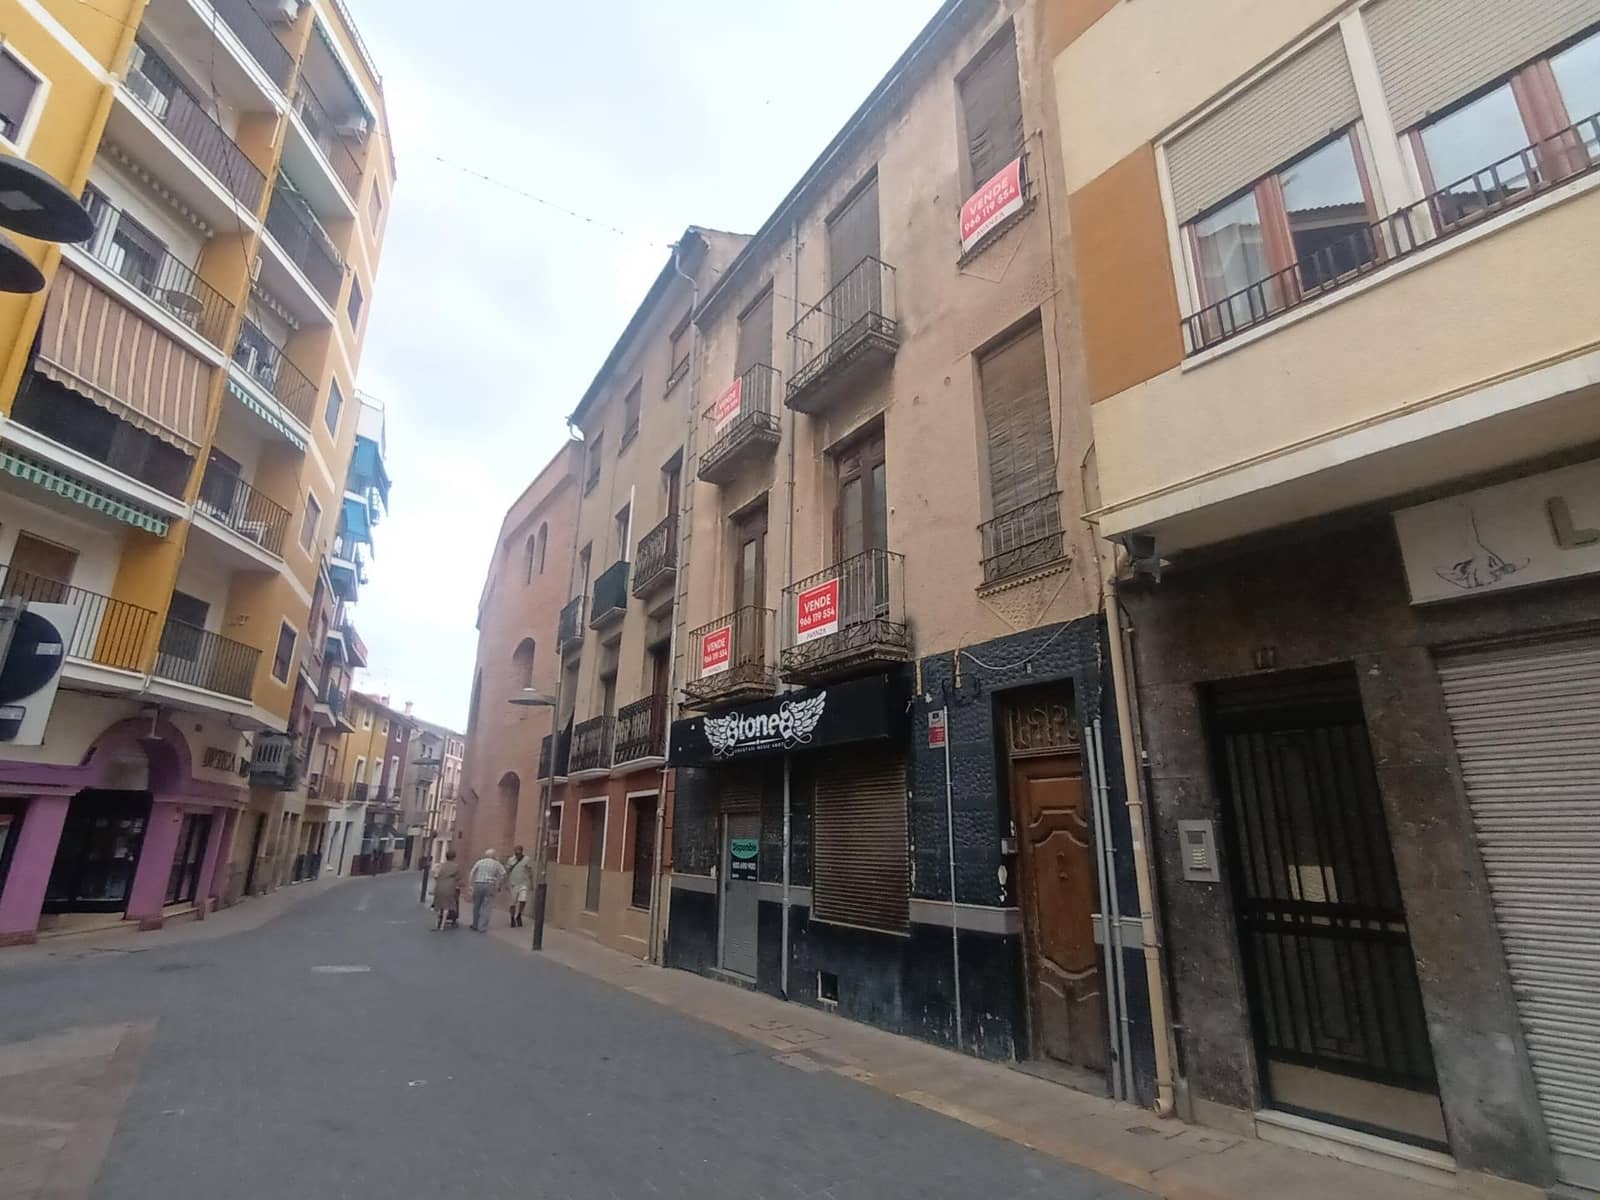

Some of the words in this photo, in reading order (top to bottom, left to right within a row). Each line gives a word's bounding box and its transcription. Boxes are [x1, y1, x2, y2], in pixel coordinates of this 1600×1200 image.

[970, 177, 1009, 215] VENDE
[965, 215, 981, 232] 966
[982, 201, 996, 216] 119
[804, 593, 831, 614] VENDE
[800, 615, 812, 627] 966
[812, 611, 822, 623] 119
[822, 606, 835, 619] 554
[707, 637, 727, 653] VENDE
